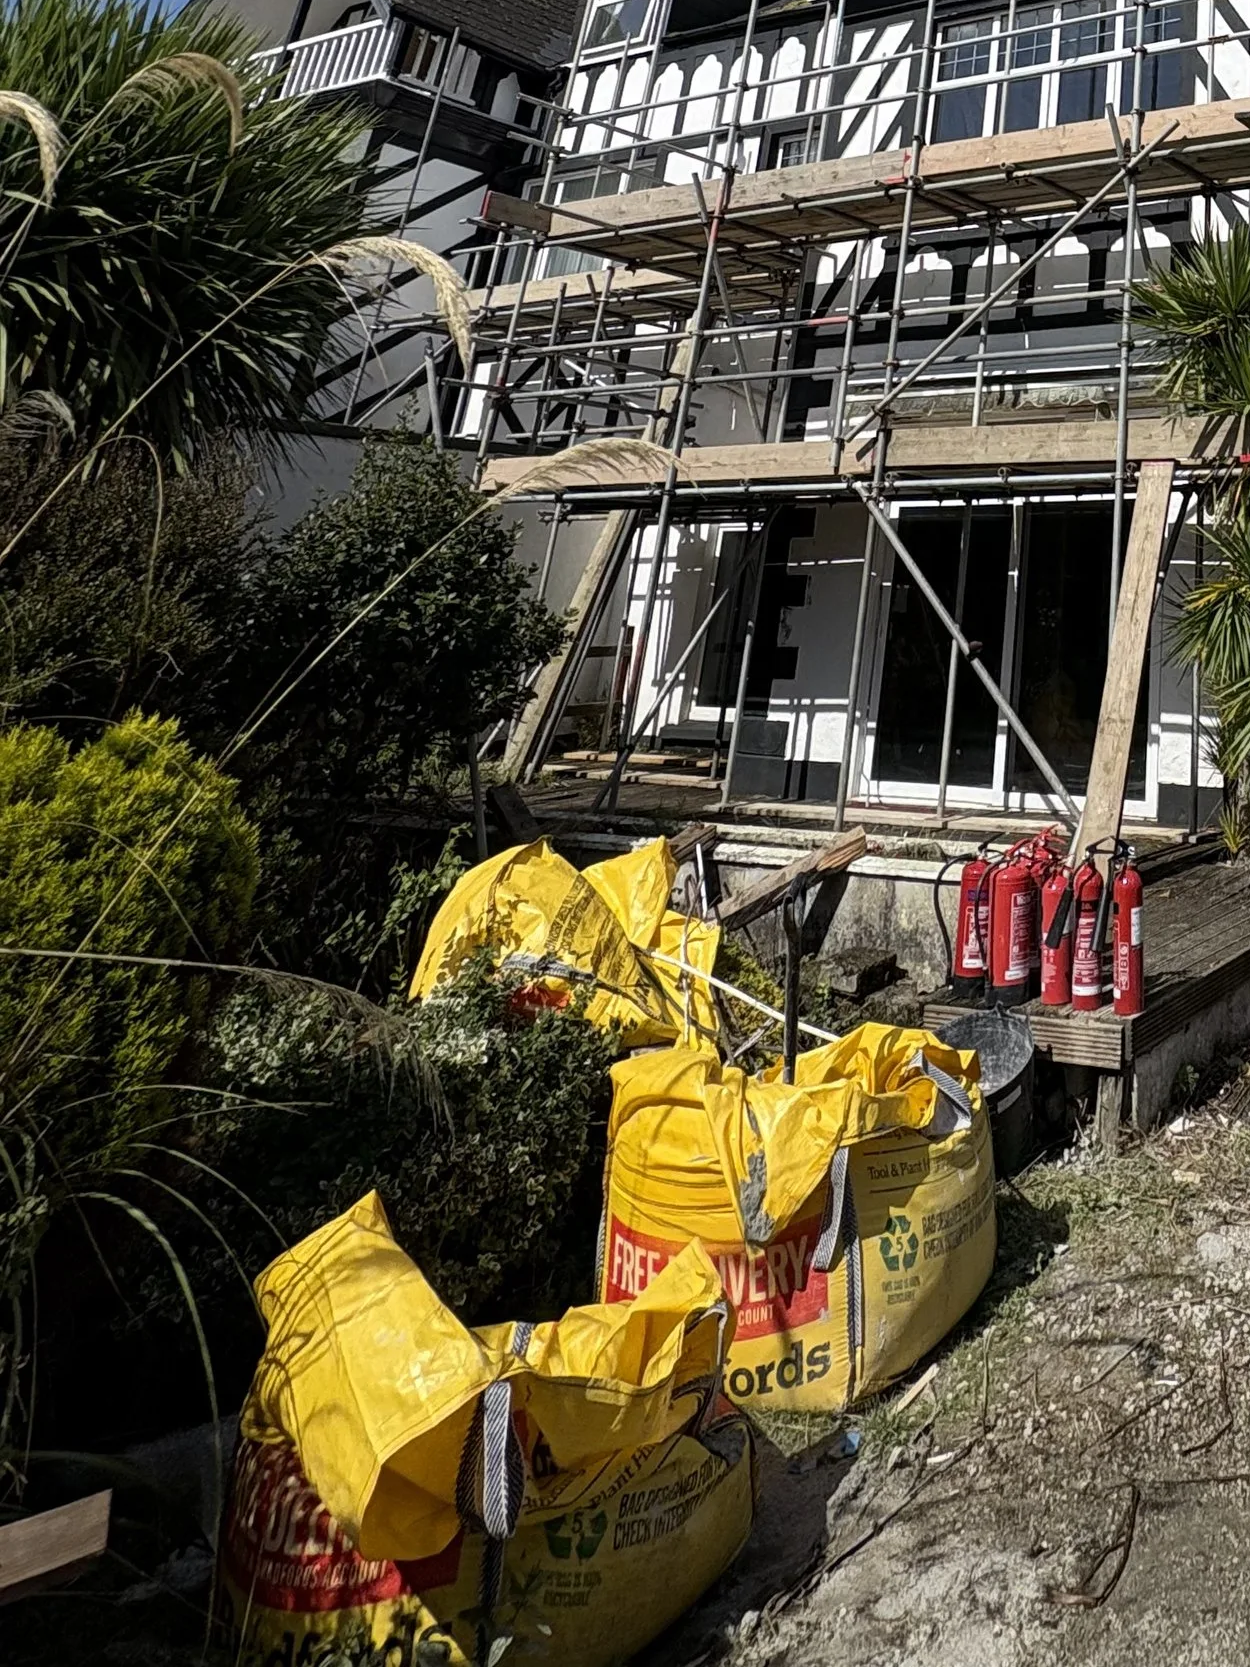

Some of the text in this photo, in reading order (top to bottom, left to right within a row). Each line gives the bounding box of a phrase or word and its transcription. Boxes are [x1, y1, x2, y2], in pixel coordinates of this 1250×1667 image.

[867, 1165, 889, 1181] Tool
[890, 1163, 899, 1177] &
[611, 1232, 662, 1296] FREE
[718, 1235, 808, 1307] IVERY
[737, 1303, 775, 1327] COUNT
[722, 1338, 832, 1399] ords
[618, 1490, 645, 1519] BAG
[612, 1517, 652, 1551] CHECK
